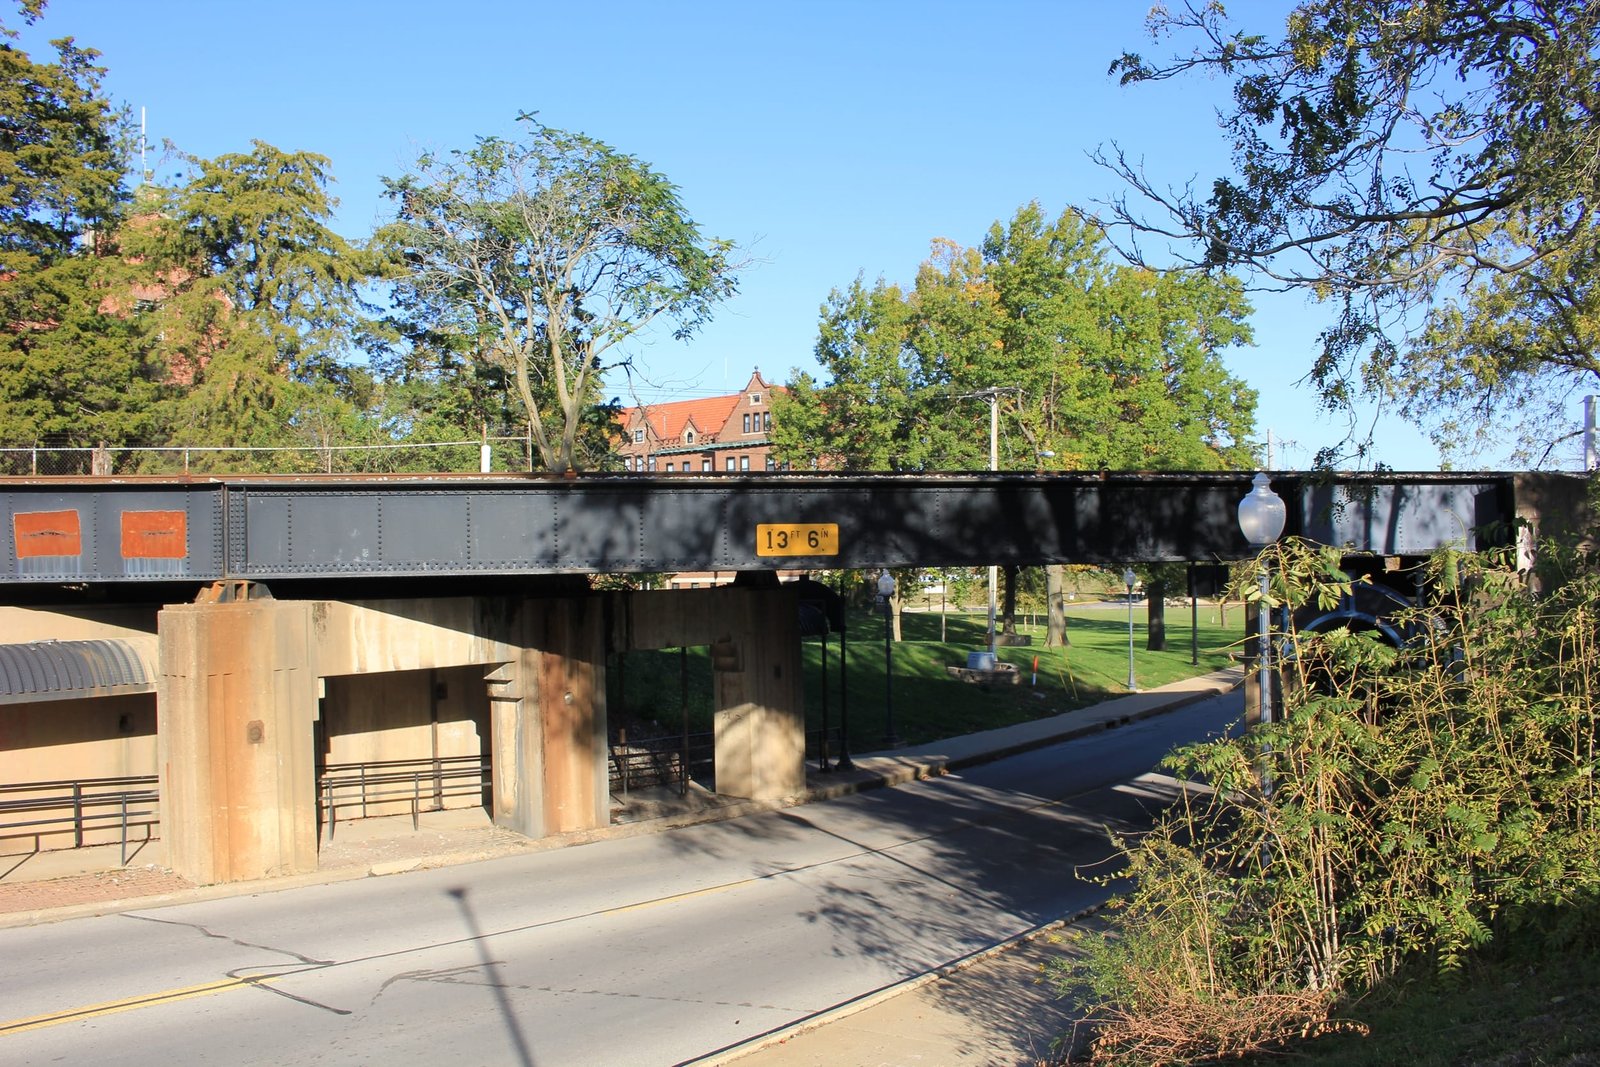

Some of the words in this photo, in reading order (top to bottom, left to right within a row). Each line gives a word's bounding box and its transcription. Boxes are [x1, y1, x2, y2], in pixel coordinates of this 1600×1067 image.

[767, 531, 788, 549] 13
[791, 530, 800, 538] FT
[808, 530, 819, 548] 6
[821, 530, 829, 538] IN
